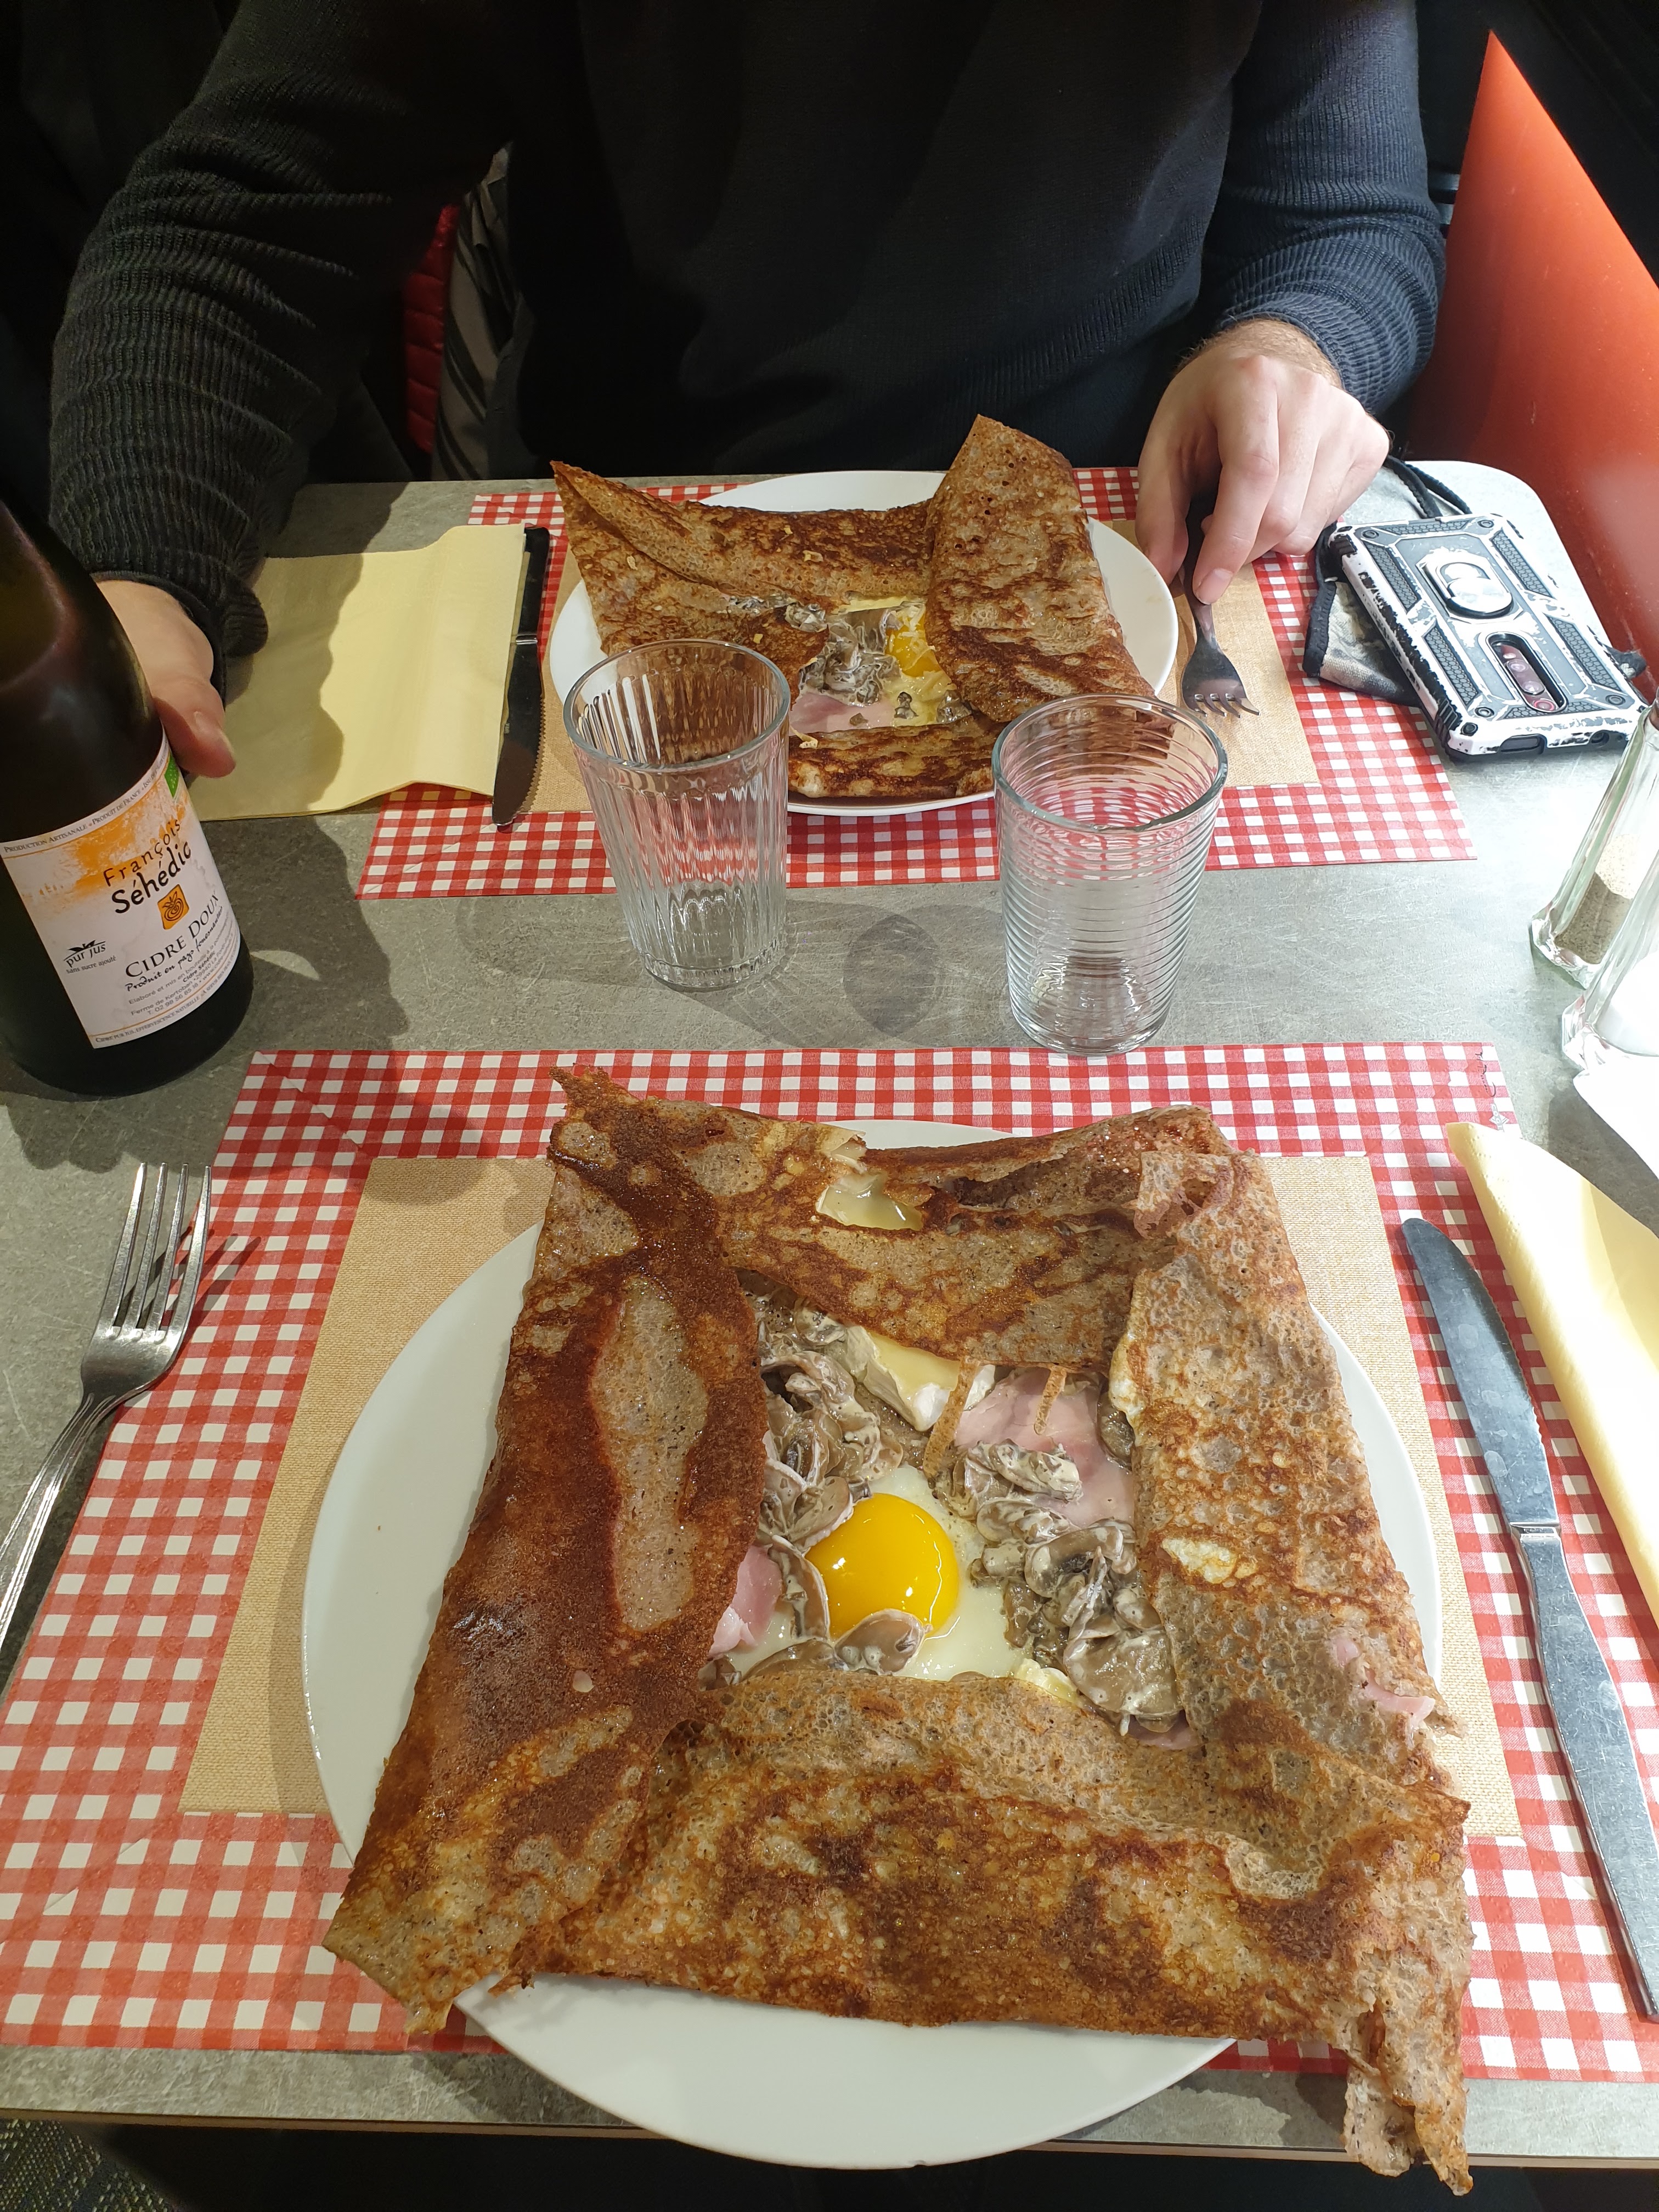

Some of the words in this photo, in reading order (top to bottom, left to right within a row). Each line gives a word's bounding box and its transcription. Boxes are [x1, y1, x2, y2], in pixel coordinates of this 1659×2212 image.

[92, 808, 116, 825] PRODUIT
[123, 788, 142, 806] FRANCE
[4, 839, 47, 853] PRODUCTION
[49, 823, 88, 843] ARTISANALE
[103, 819, 180, 887] François
[111, 841, 191, 914] Séhédic
[125, 935, 187, 978] CIDRE
[188, 890, 219, 939] DOUX
[66, 951, 86, 968] pur
[88, 944, 106, 959] jus
[81, 962, 97, 970] sucre
[125, 971, 162, 992] Produit
[164, 965, 176, 974] en
[177, 949, 195, 970] pays
[183, 969, 198, 983] Cidre
[128, 990, 156, 1005] Elaboré
[166, 978, 177, 988] mis
[165, 999, 174, 1007] 98
[175, 994, 184, 1002] 56
[131, 1003, 154, 1016] Ferme
